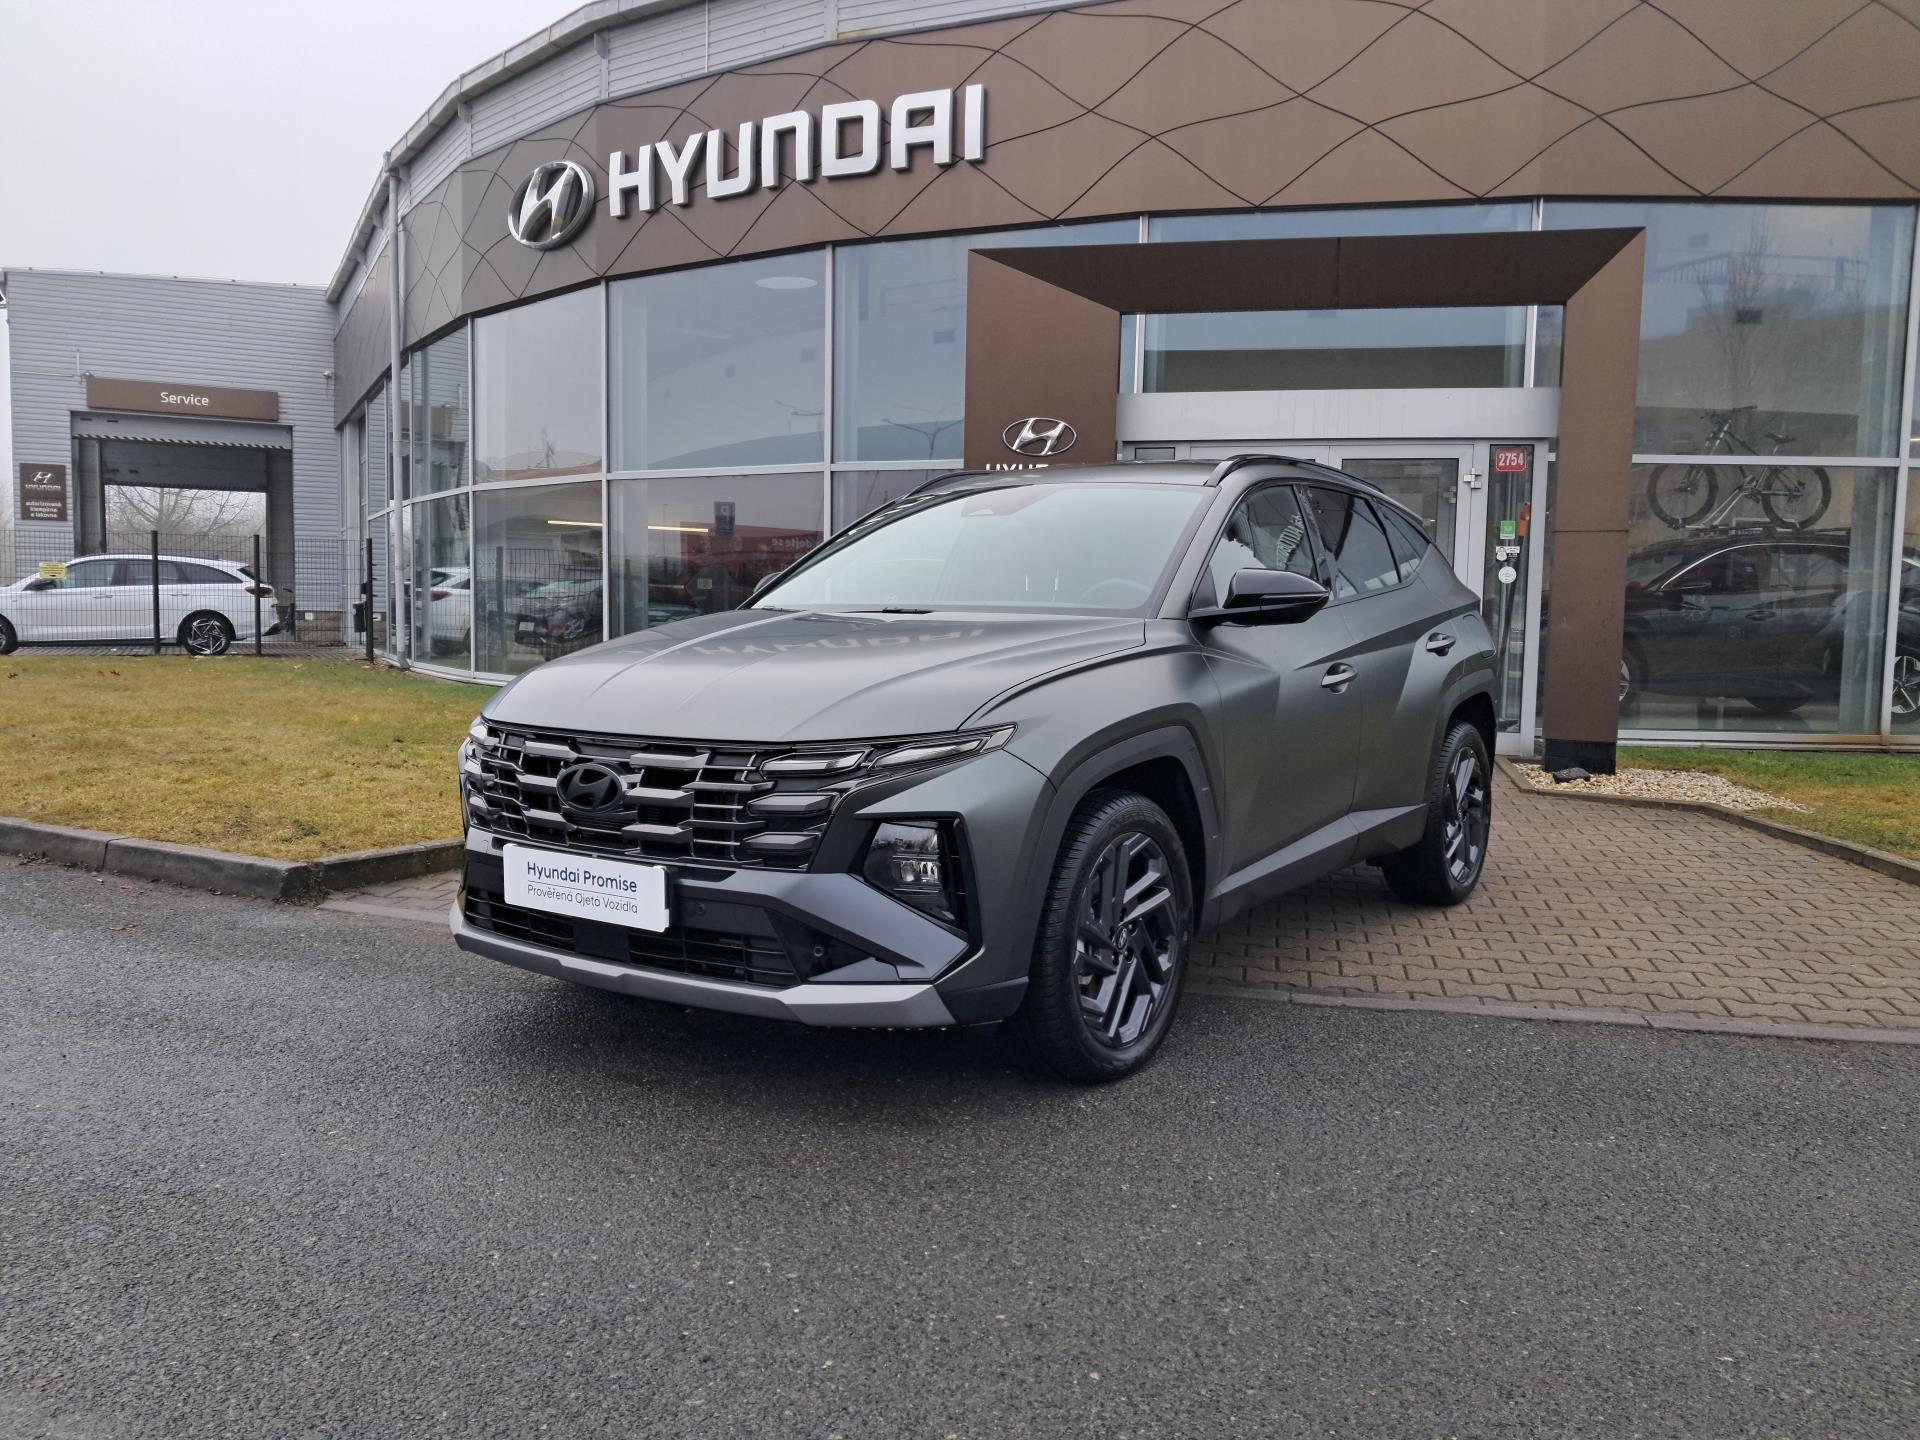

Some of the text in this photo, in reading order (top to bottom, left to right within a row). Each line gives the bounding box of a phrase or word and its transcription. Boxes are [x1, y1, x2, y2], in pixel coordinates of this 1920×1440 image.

[608, 83, 985, 218] HYUNDAI
[160, 391, 209, 406] Service
[1498, 452, 1524, 466] 2754
[527, 861, 637, 893] Hyundai Promise
[527, 884, 573, 902] Prověřená
[602, 896, 638, 914] Vozidla
